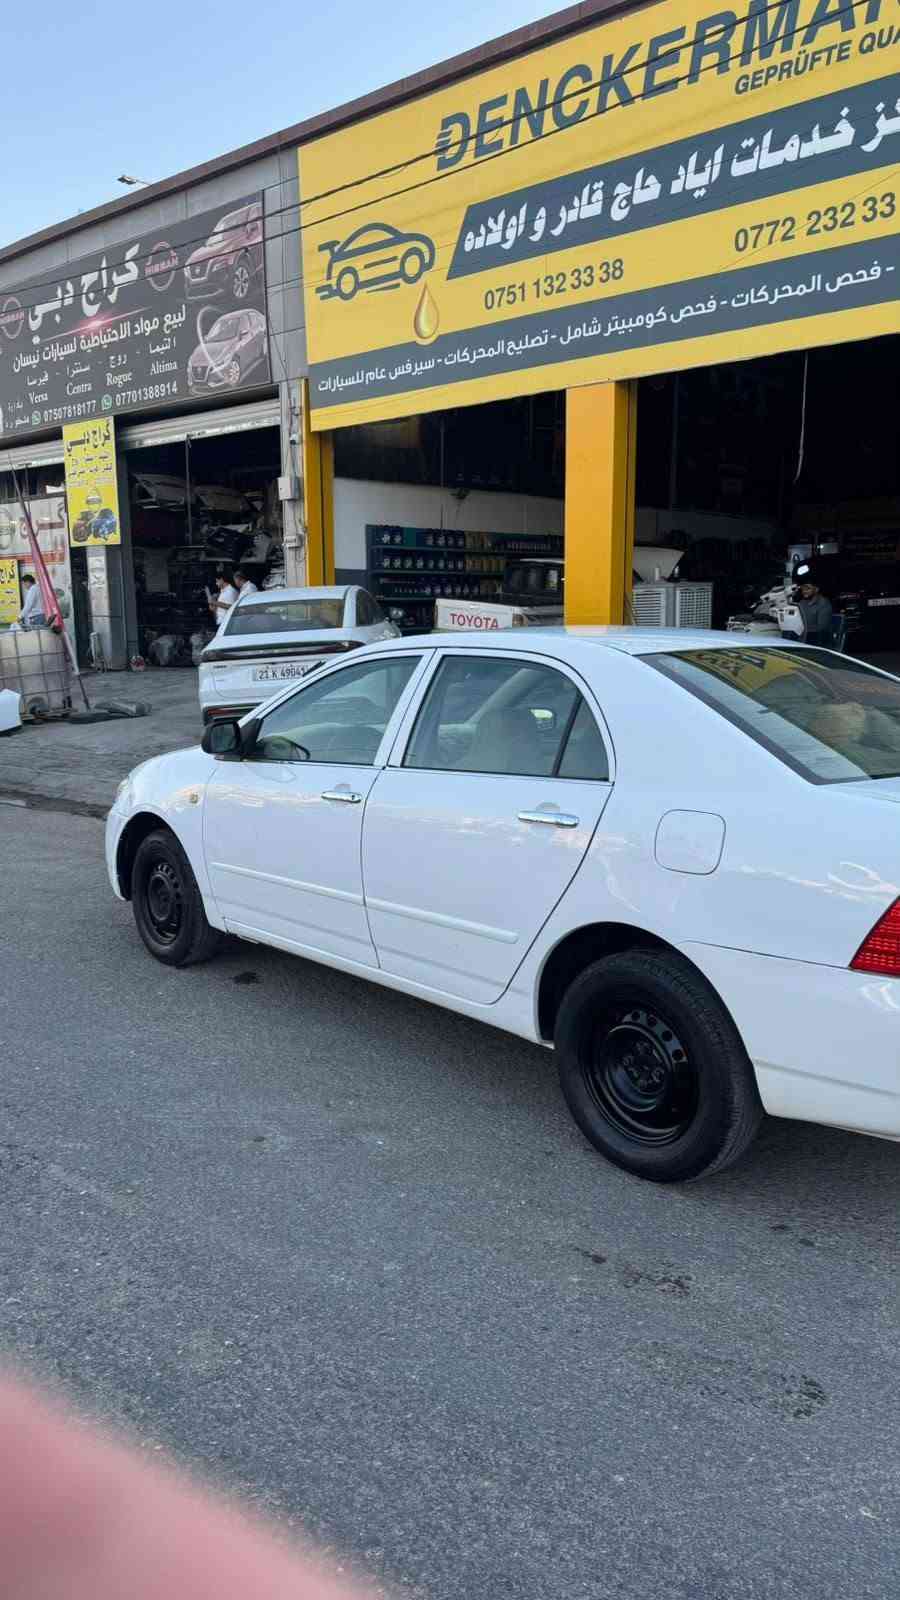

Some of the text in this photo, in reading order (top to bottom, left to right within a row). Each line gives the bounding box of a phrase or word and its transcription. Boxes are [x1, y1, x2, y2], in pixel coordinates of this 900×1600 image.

[735, 39, 853, 95] GEPRÜFTE
[730, 106, 856, 177] خدمات
[550, 180, 605, 236] قادر
[610, 167, 661, 221] حاج
[464, 202, 528, 252] اولاده
[529, 206, 546, 242] و
[734, 191, 896, 252] 0772 232 33
[484, 258, 624, 310] 0751 132 33 38
[730, 273, 822, 308] المحركات
[825, 260, 882, 292] فحص
[28, 243, 140, 345] كراج دبي
[670, 295, 717, 323] فحص
[134, 316, 159, 336] مواد
[163, 304, 186, 334] لبيع
[559, 317, 601, 345] شامل
[603, 306, 667, 337] كومبيتر
[444, 340, 505, 365] المحركات
[506, 330, 550, 355] تصليح
[13, 350, 40, 373] نيسان
[366, 367, 387, 384] عام
[389, 359, 436, 380] سيرفس
[317, 369, 366, 391] للسيارات
[450, 613, 498, 630] TOYOTA
